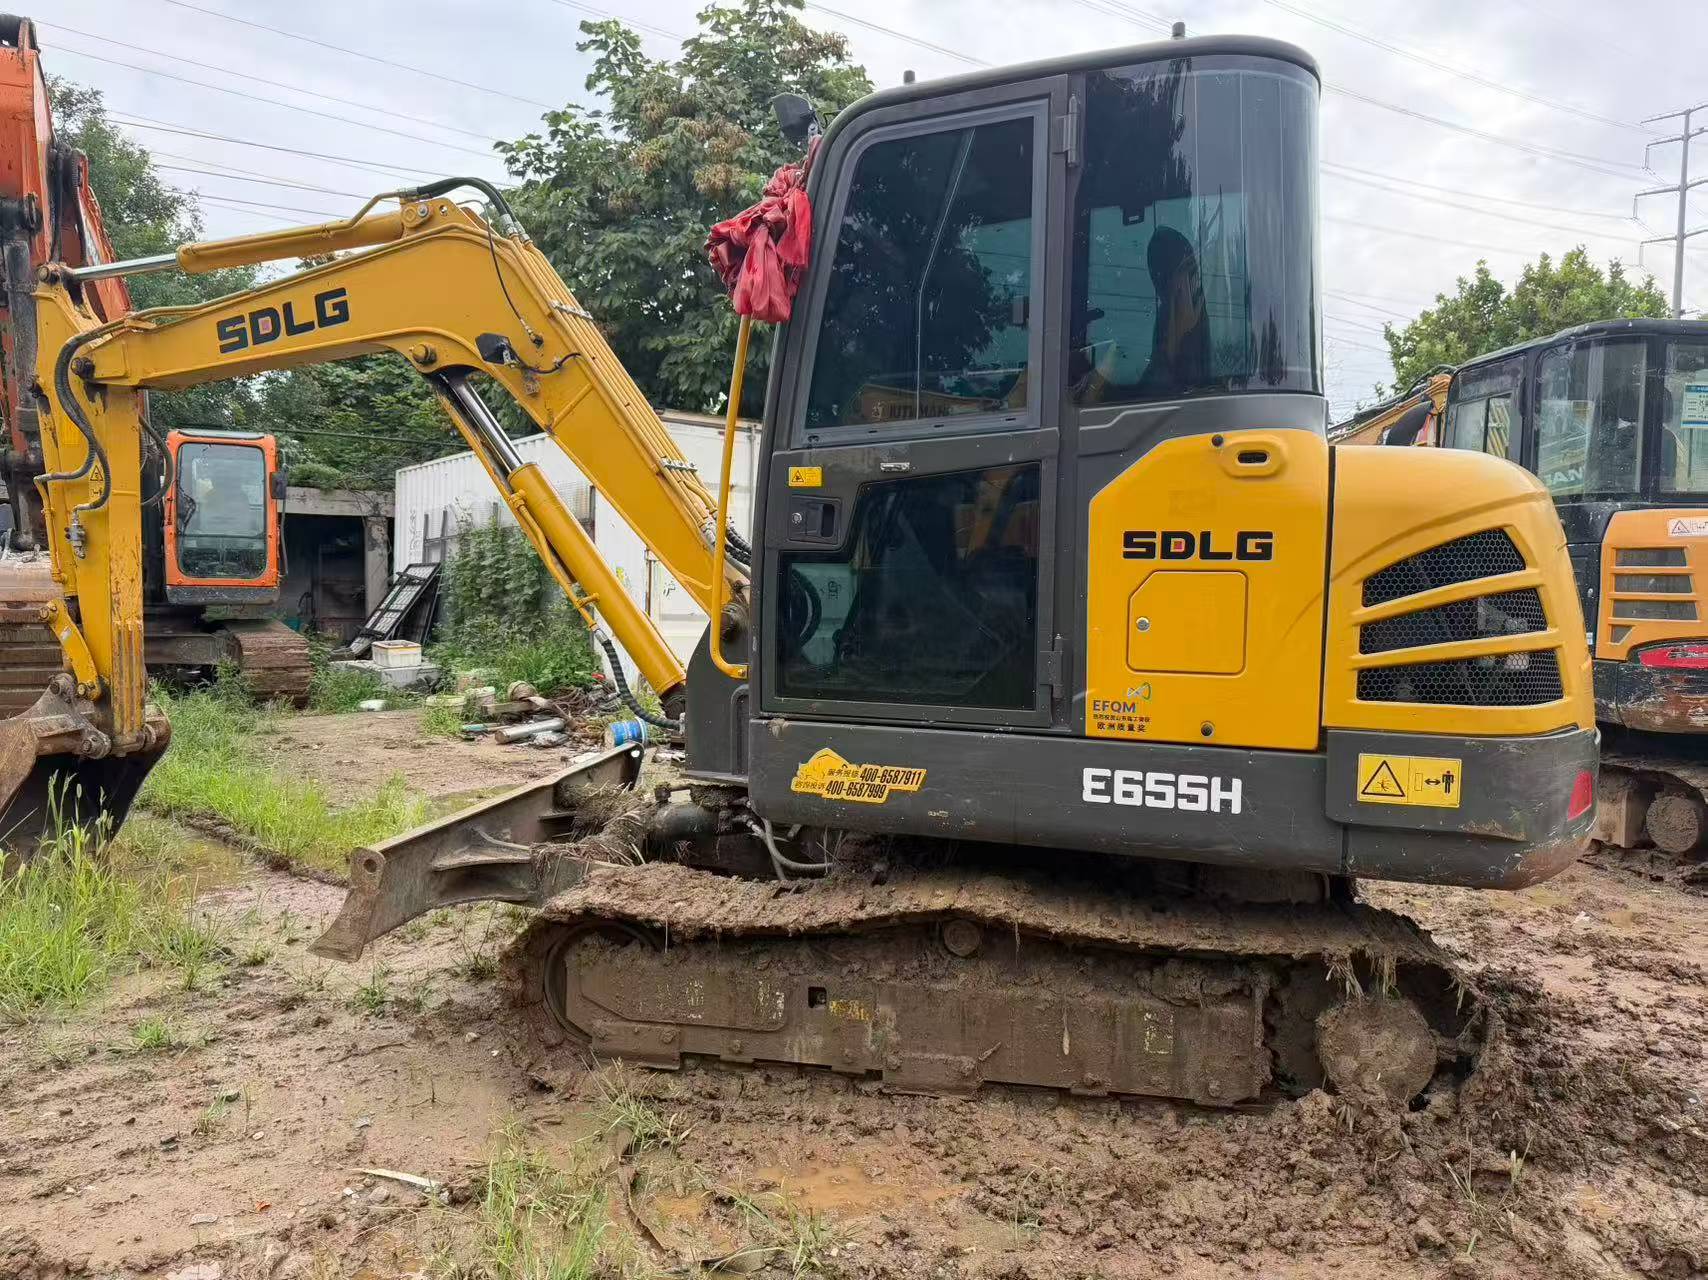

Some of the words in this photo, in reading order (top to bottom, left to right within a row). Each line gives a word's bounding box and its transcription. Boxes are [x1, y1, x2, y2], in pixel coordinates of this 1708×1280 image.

[217, 287, 350, 354] SDLG
[1122, 530, 1273, 560] SDLG
[1093, 700, 1136, 713] EFQM
[860, 768, 922, 785] 400-6587911
[826, 781, 887, 798] 400-6587999
[1082, 767, 1243, 815] E655H
